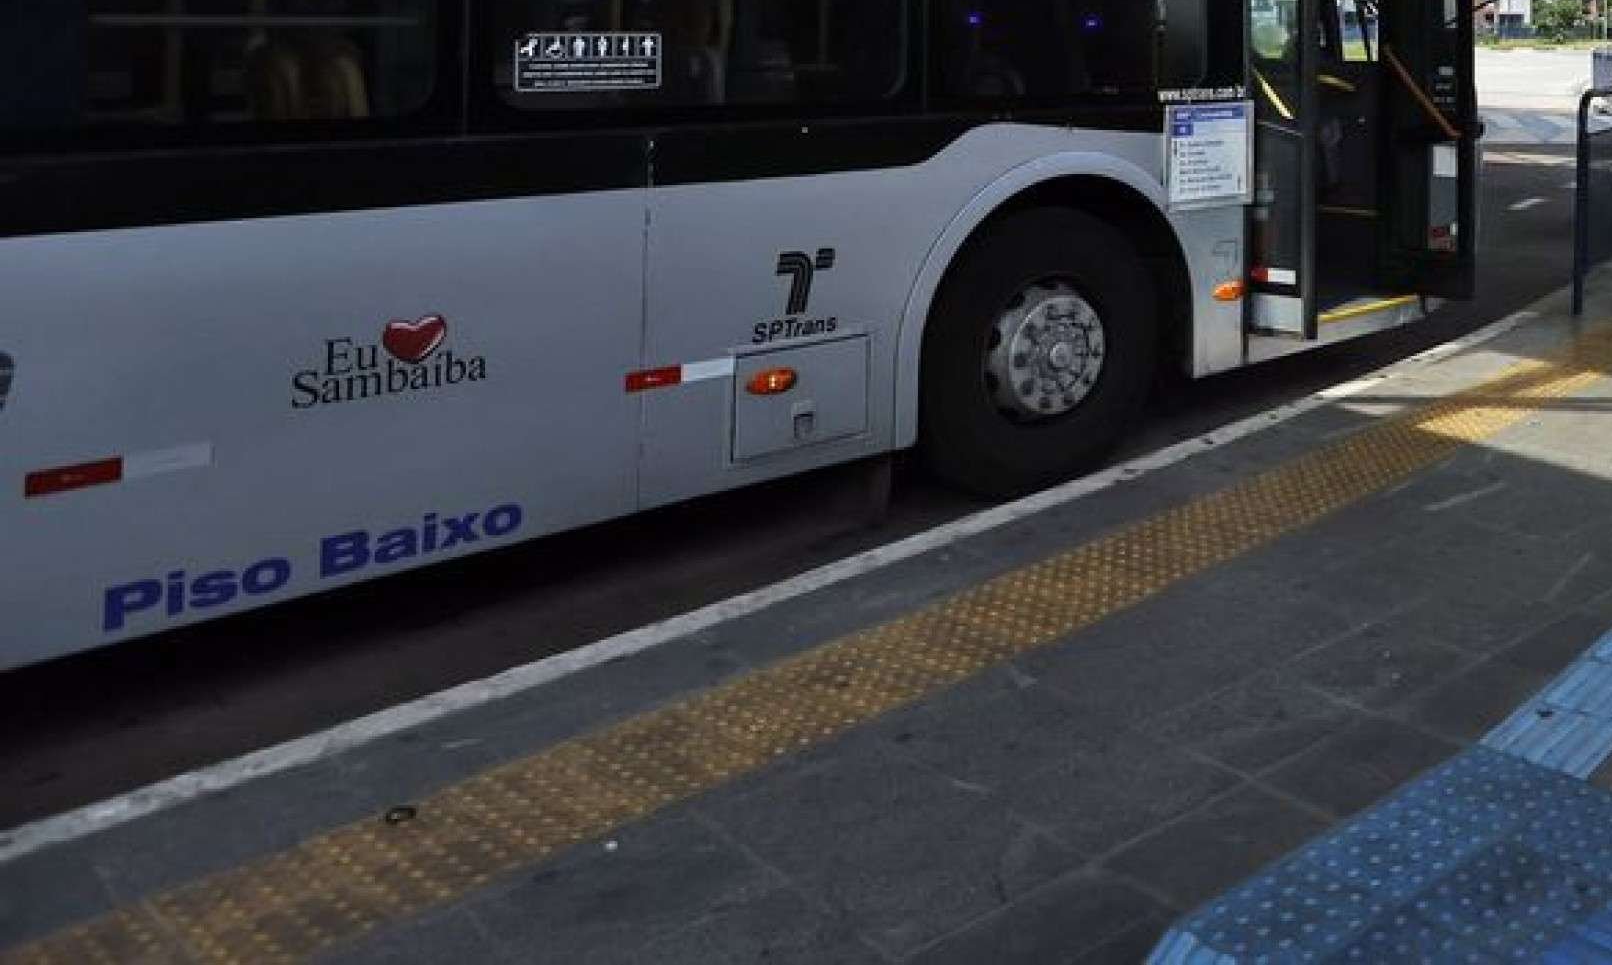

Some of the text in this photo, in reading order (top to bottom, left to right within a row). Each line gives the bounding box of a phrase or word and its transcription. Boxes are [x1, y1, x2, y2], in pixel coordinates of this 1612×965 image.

[752, 316, 837, 343] SPTrans
[324, 335, 379, 376] Eu
[102, 503, 523, 633] Piso Baixo
